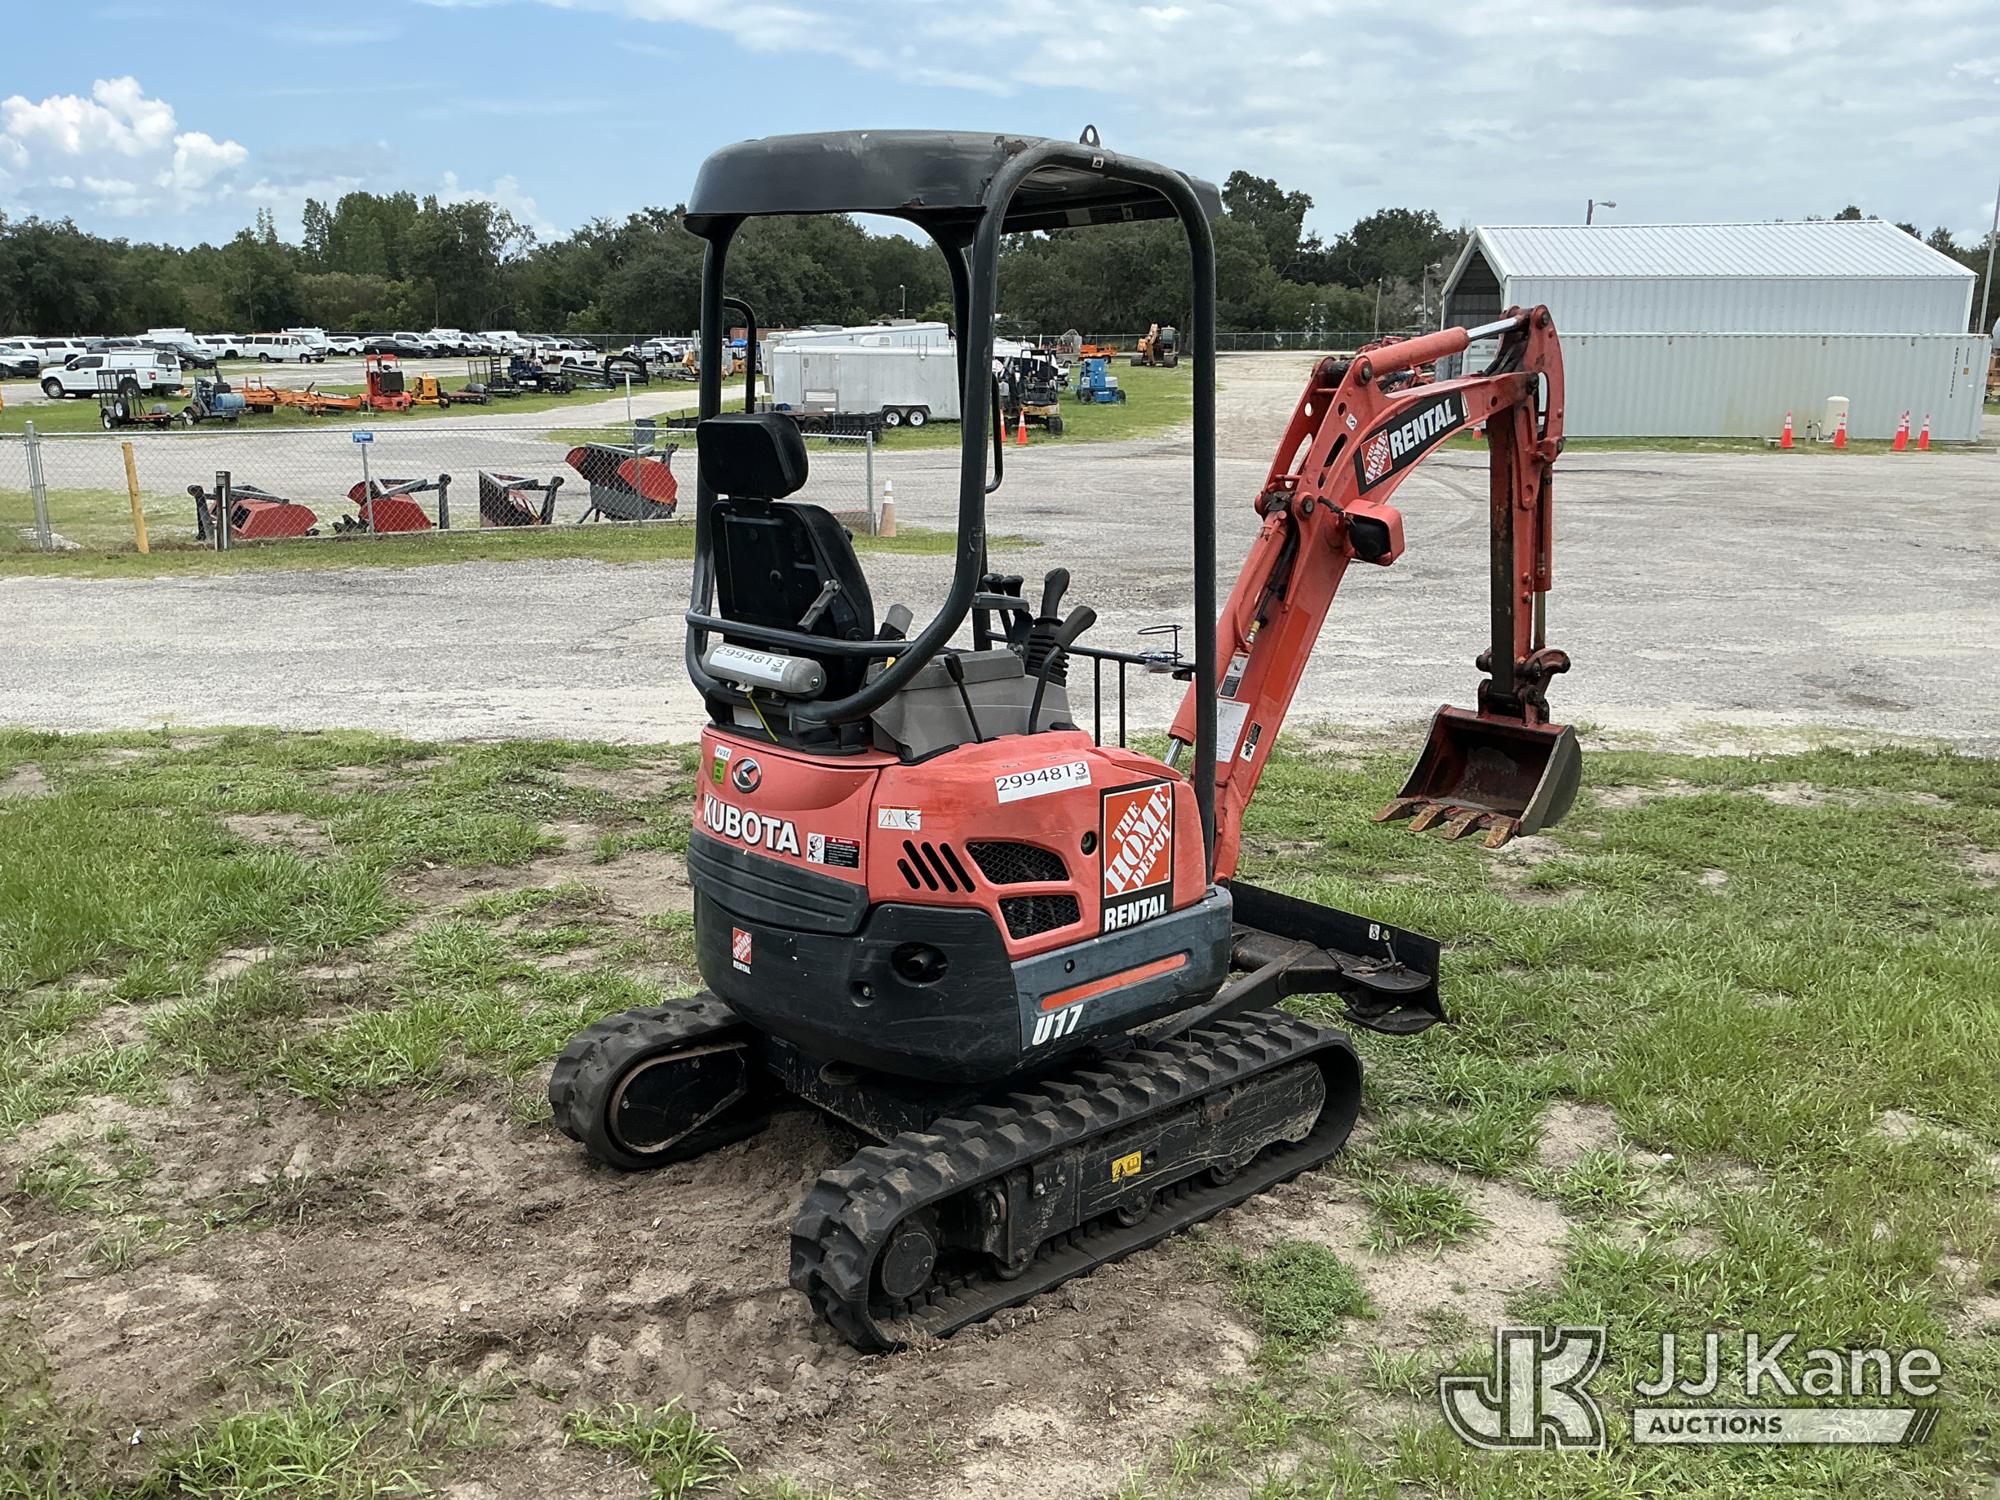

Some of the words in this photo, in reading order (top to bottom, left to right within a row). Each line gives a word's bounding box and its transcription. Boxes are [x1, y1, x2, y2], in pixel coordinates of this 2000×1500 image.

[1389, 399, 1457, 460] RENTAL
[715, 646, 785, 668] 2994813
[996, 762, 1087, 792] 2994813
[704, 794, 801, 856] KUBOTA
[1105, 785, 1171, 894] HOME
[1112, 800, 1141, 844] THE
[1131, 820, 1170, 889] DEPOT
[1104, 893, 1168, 932] RENTAL
[1032, 1003, 1084, 1046] U17
